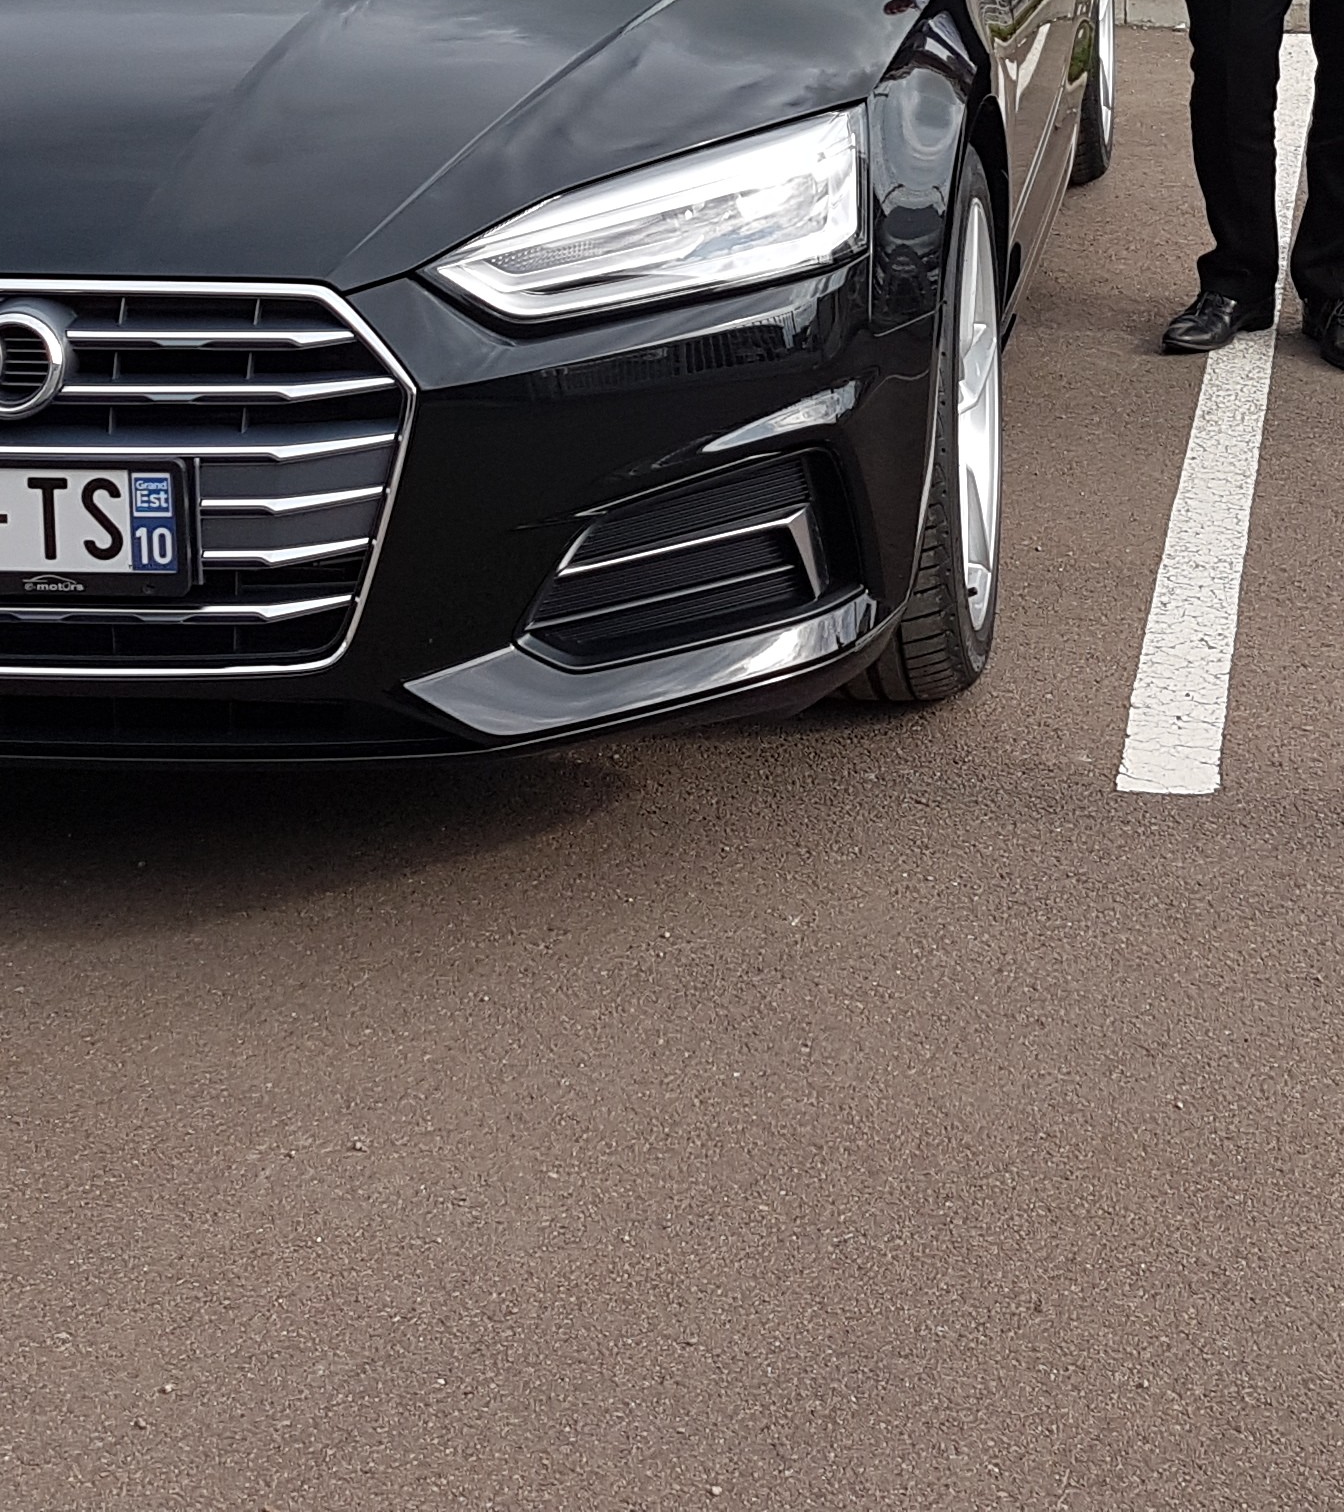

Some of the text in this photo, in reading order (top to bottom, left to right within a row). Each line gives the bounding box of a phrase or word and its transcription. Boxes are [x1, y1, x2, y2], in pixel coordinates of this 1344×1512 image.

[135, 480, 168, 490] Grand
[136, 490, 169, 508] Est
[135, 527, 173, 565] 10
